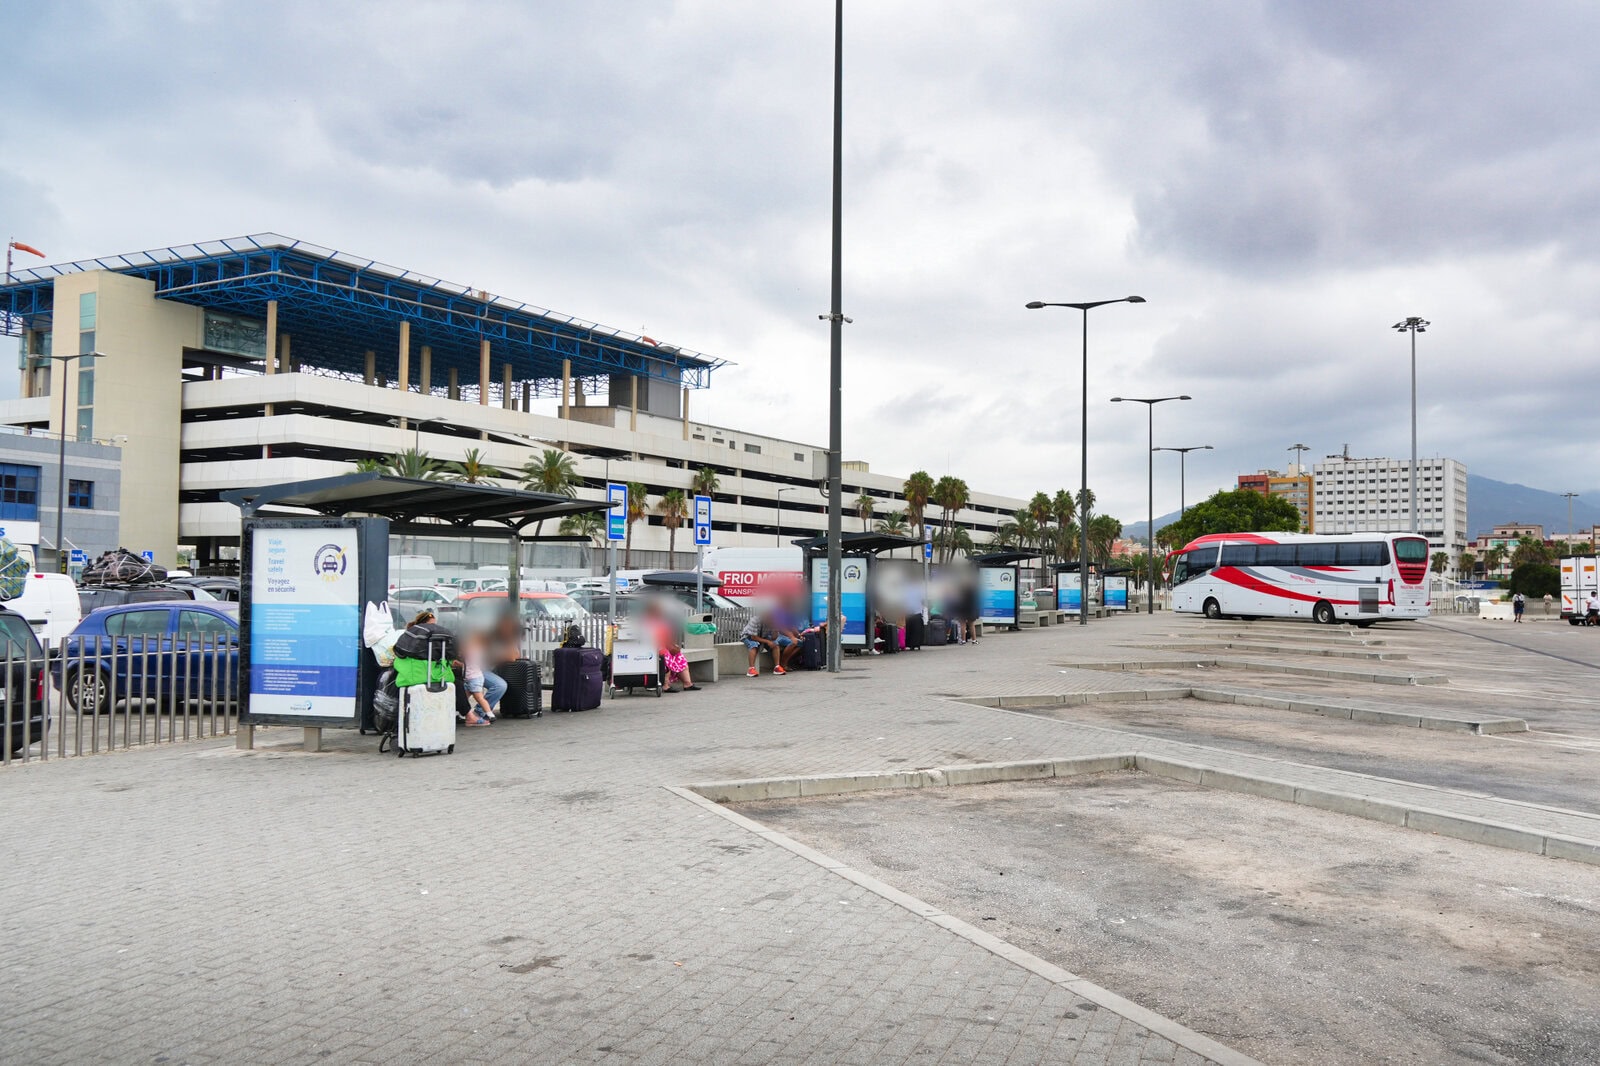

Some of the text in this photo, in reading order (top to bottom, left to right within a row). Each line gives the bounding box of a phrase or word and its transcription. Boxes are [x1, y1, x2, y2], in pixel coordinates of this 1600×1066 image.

[267, 577, 290, 585] Voyagez
[723, 573, 754, 585] FRIO
[275, 585, 296, 593] sécurité
